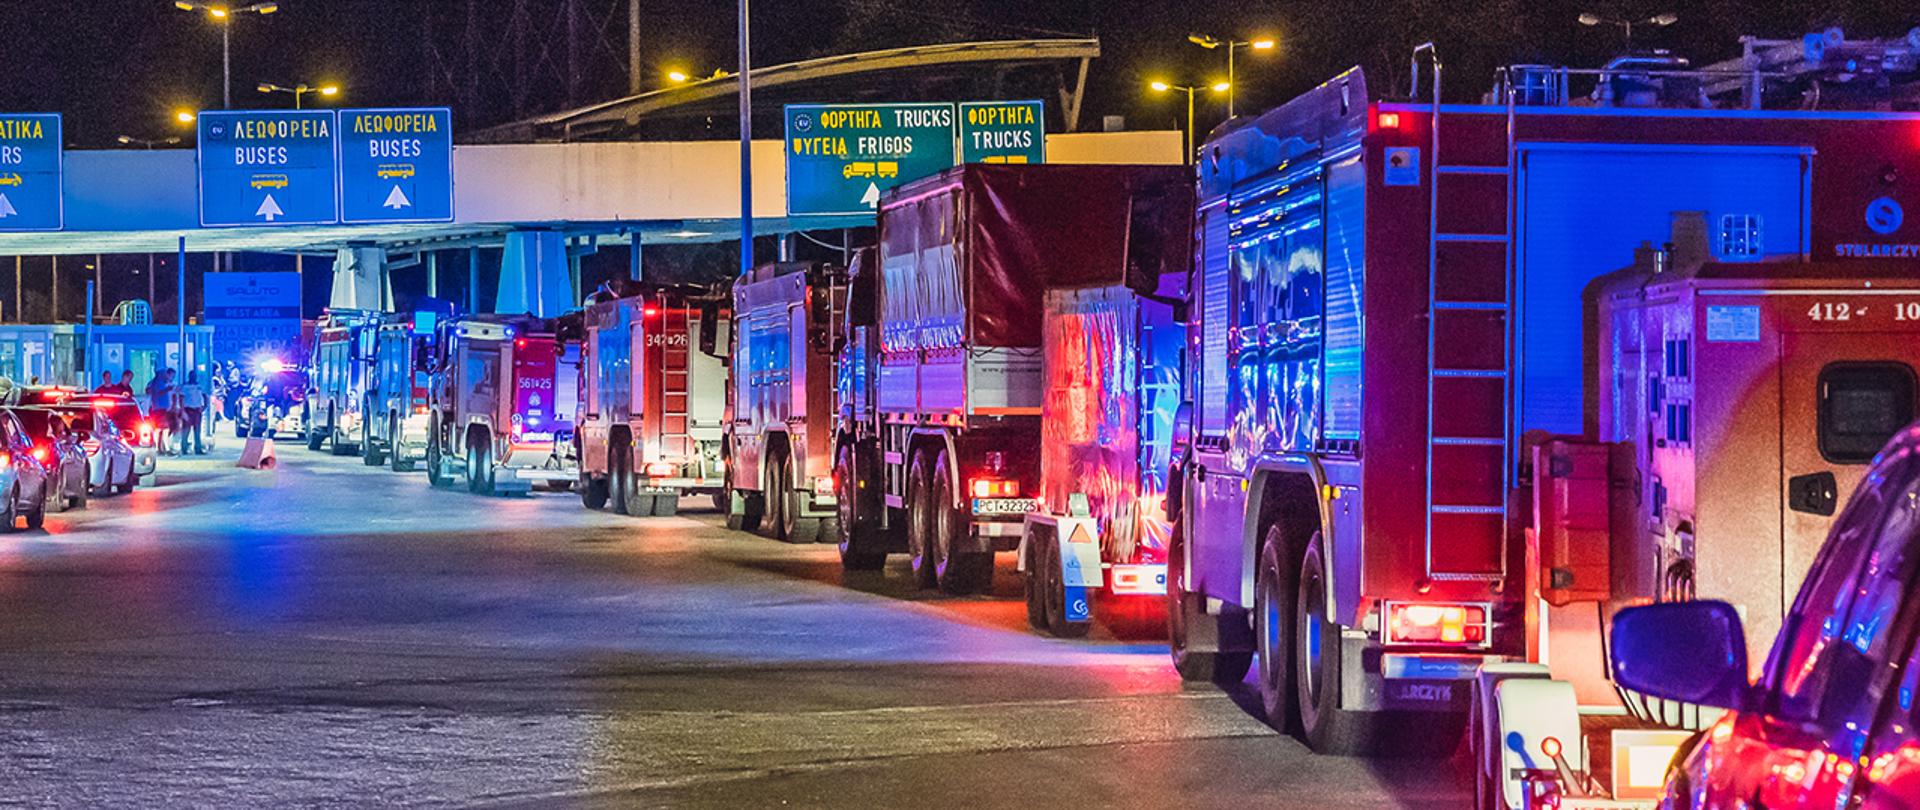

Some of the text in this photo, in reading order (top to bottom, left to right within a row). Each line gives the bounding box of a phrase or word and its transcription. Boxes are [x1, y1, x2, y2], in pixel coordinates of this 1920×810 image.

[354, 114, 437, 133] ΛΕΩΦΟΡΕΙΑ
[820, 109, 951, 129] ΦΟΡΤΗΓΑ TRUCKS
[968, 107, 1035, 126] ΦΟΡΤΗΓΑ
[235, 119, 329, 139] ΛΕΩΦΟΡΕΙΑ
[369, 139, 421, 157] BUSES
[793, 136, 913, 156] ΨΥΓΕΙΑ FRIGOS
[972, 130, 1032, 149] TRUCKS
[235, 146, 288, 165] BUSES
[225, 308, 280, 318] REST AREA
[1807, 302, 1920, 321] 412 10
[519, 376, 552, 389] 561 25
[979, 500, 999, 512] PCT
